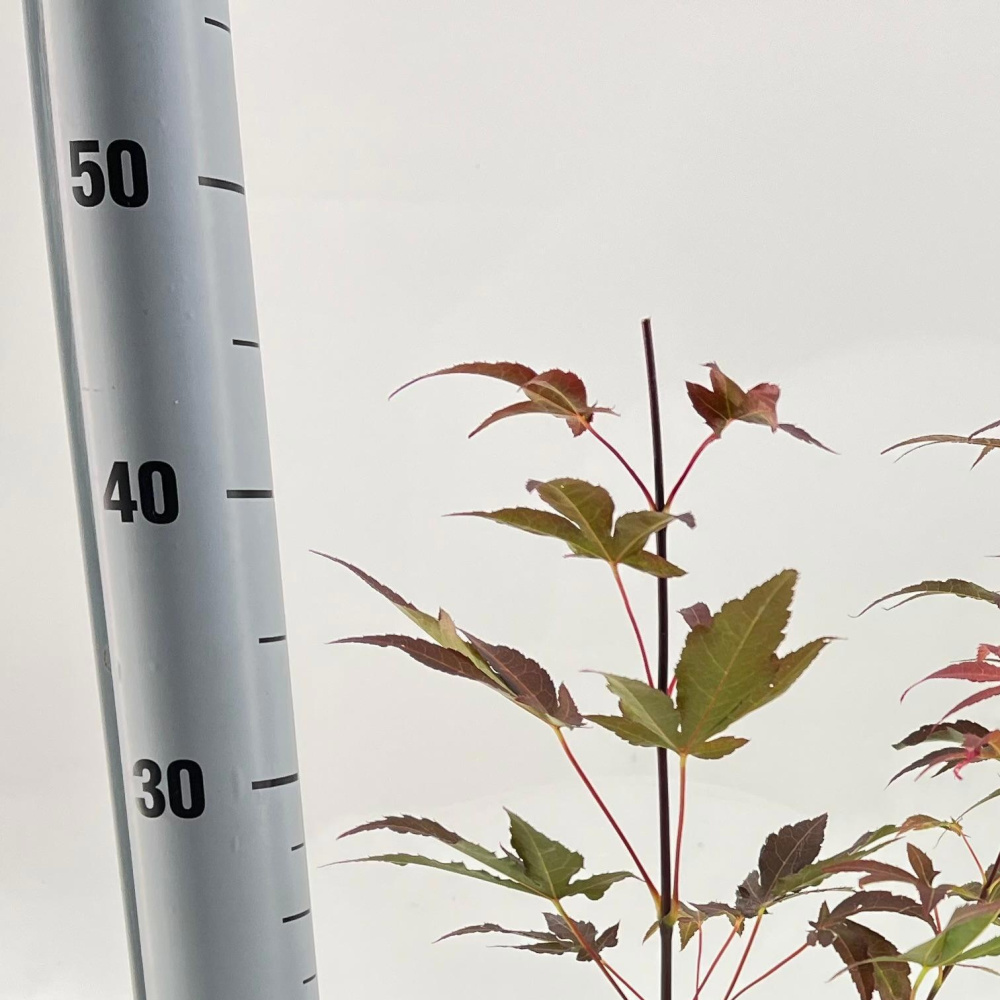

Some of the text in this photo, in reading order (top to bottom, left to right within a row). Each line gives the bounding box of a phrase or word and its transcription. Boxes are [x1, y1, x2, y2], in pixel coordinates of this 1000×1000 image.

[70, 139, 149, 208] 50
[105, 460, 180, 525] 40
[133, 758, 205, 819] 30
